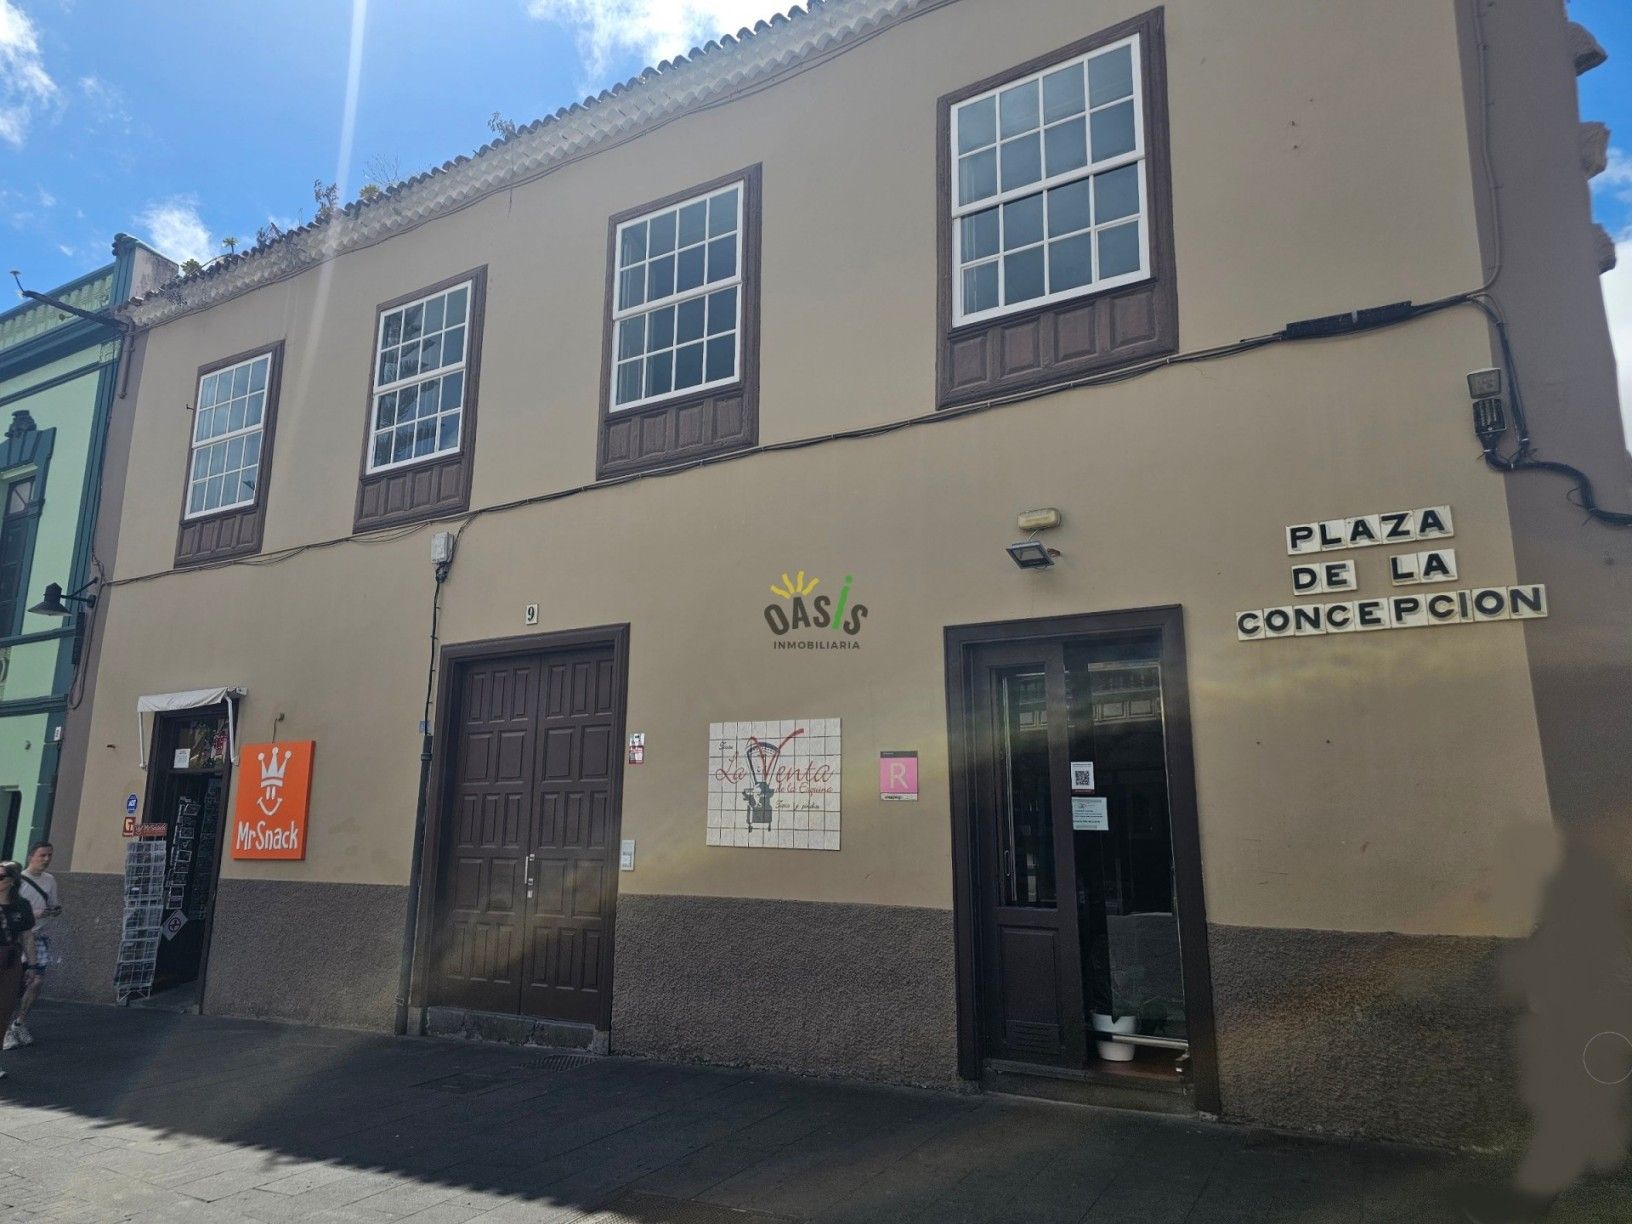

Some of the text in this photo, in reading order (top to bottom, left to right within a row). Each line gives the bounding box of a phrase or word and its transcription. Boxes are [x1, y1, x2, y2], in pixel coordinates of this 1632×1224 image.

[1289, 509, 1446, 549] PLAZA
[1292, 552, 1450, 590] DE LA
[527, 606, 535, 622] 9
[1237, 586, 1543, 635] CONCEPCION
[715, 727, 835, 785] La Venta
[890, 762, 910, 790] R
